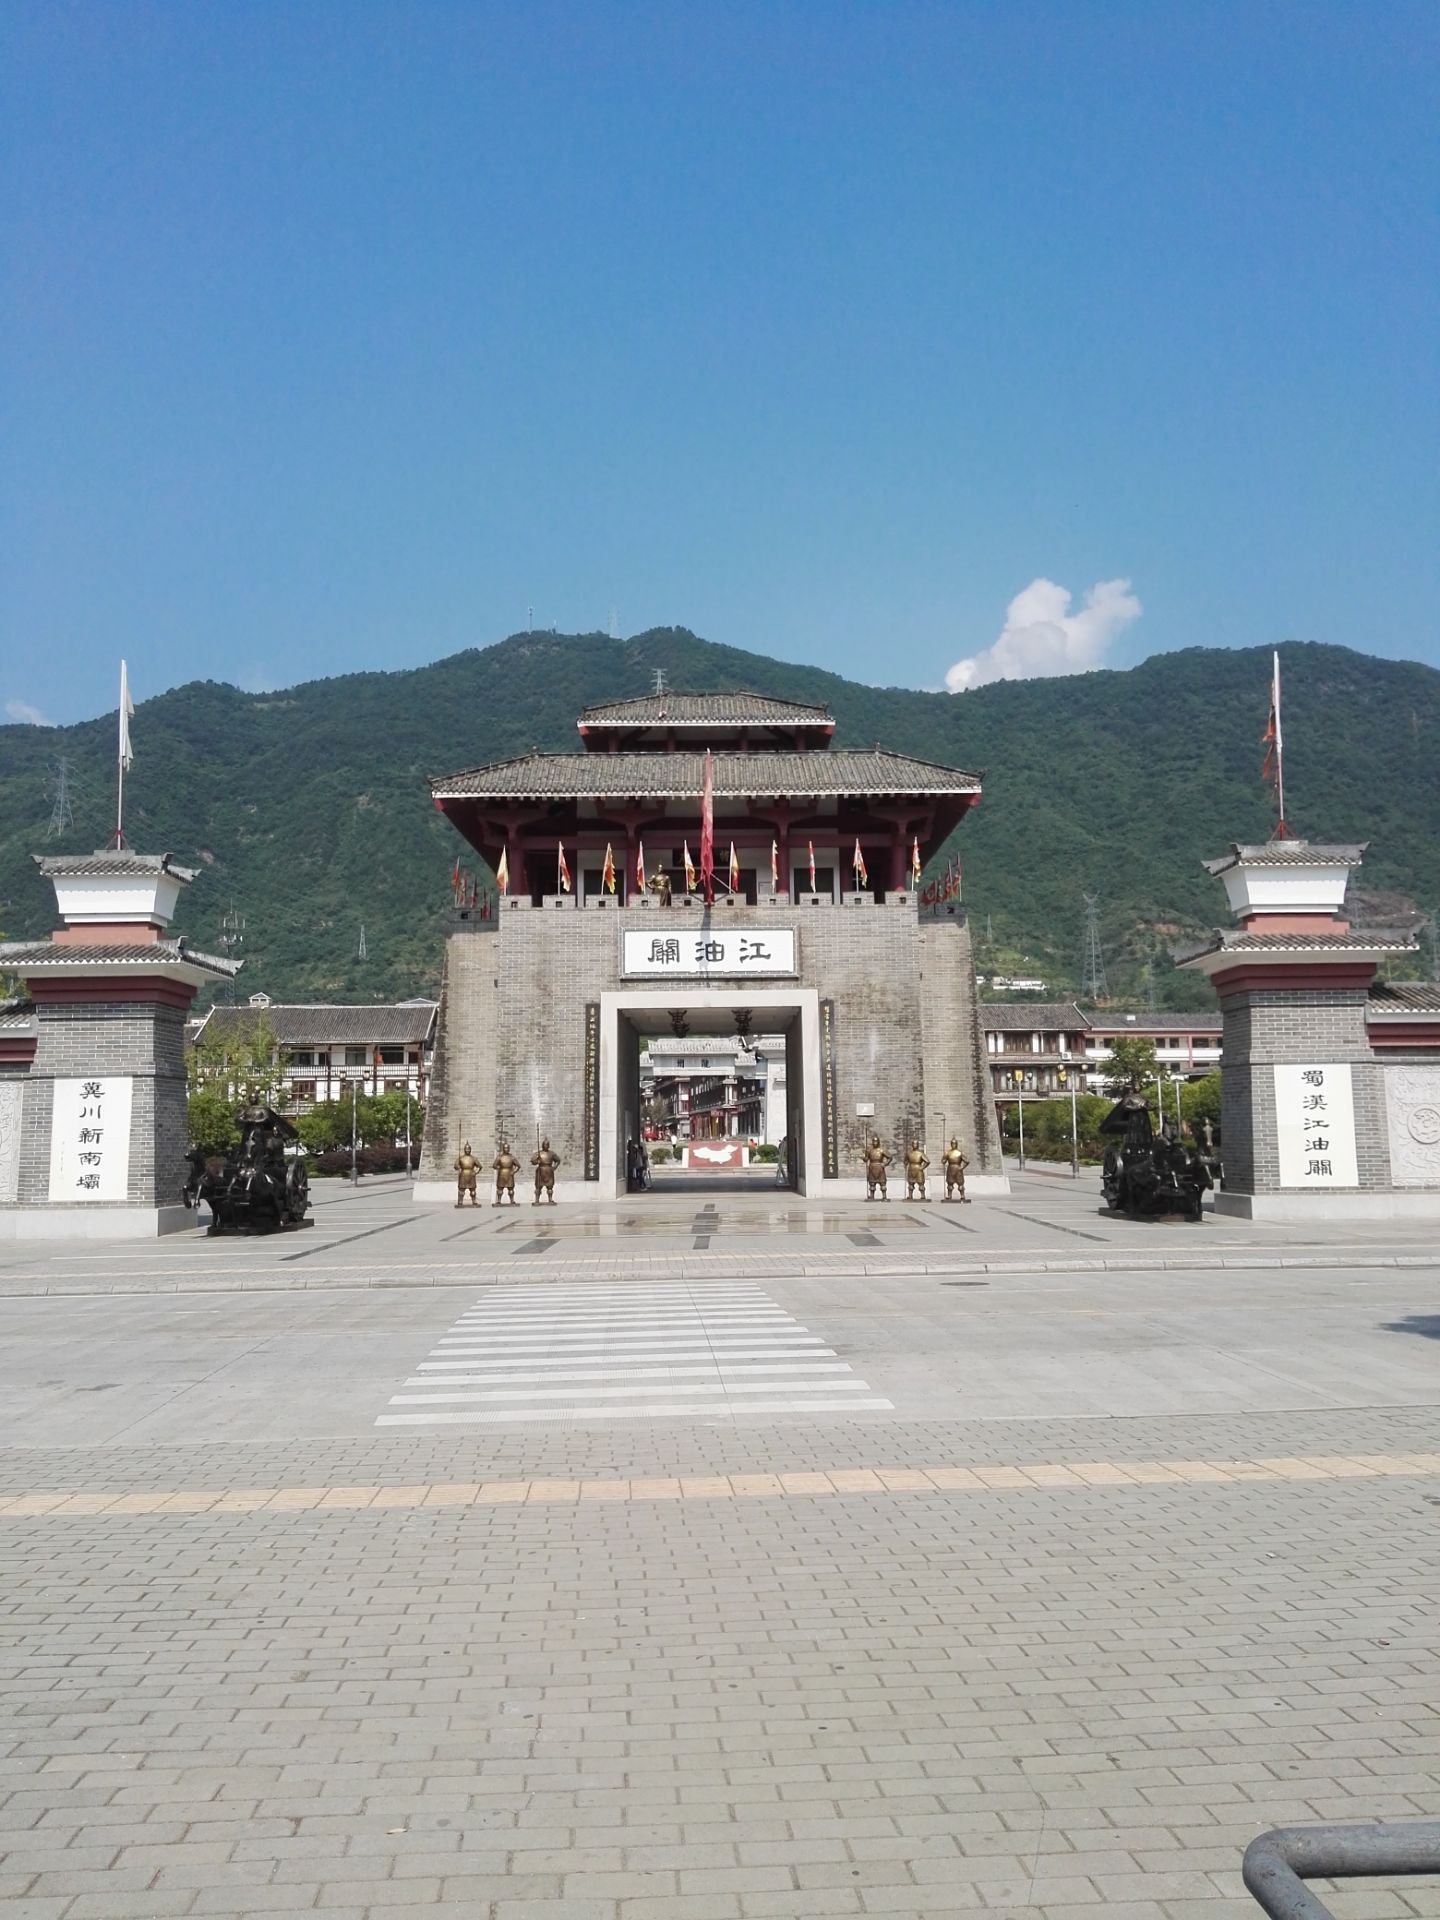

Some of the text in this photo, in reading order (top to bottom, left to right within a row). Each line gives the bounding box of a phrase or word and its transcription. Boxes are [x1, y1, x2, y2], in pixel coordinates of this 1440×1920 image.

[1300, 1069, 1333, 1176] 蜀漢江油關
